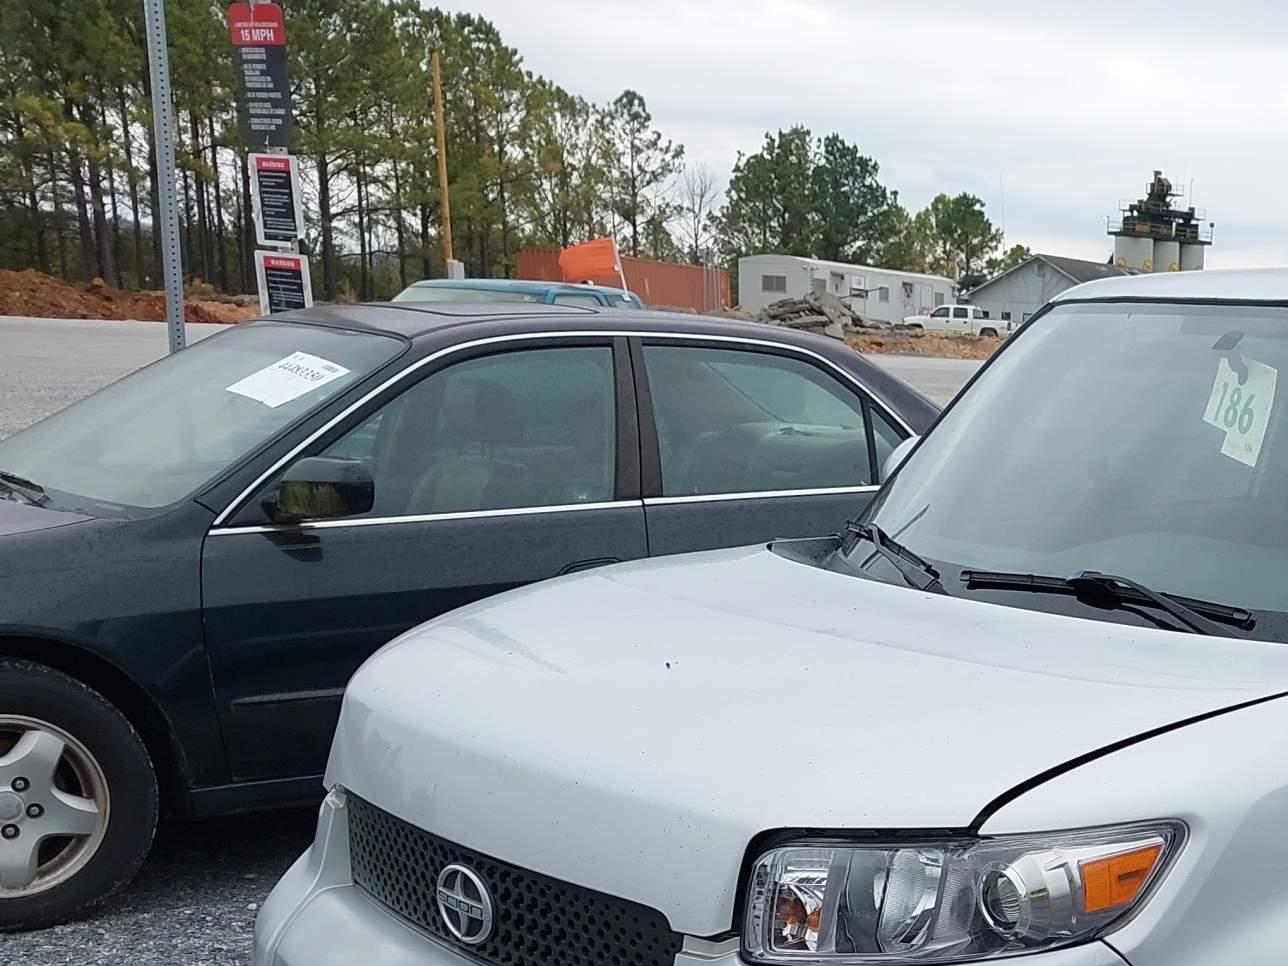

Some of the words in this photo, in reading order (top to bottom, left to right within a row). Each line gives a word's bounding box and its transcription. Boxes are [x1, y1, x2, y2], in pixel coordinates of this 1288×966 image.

[240, 29, 250, 41] 15
[251, 28, 274, 41] MPH
[1214, 382, 1256, 434] 186
